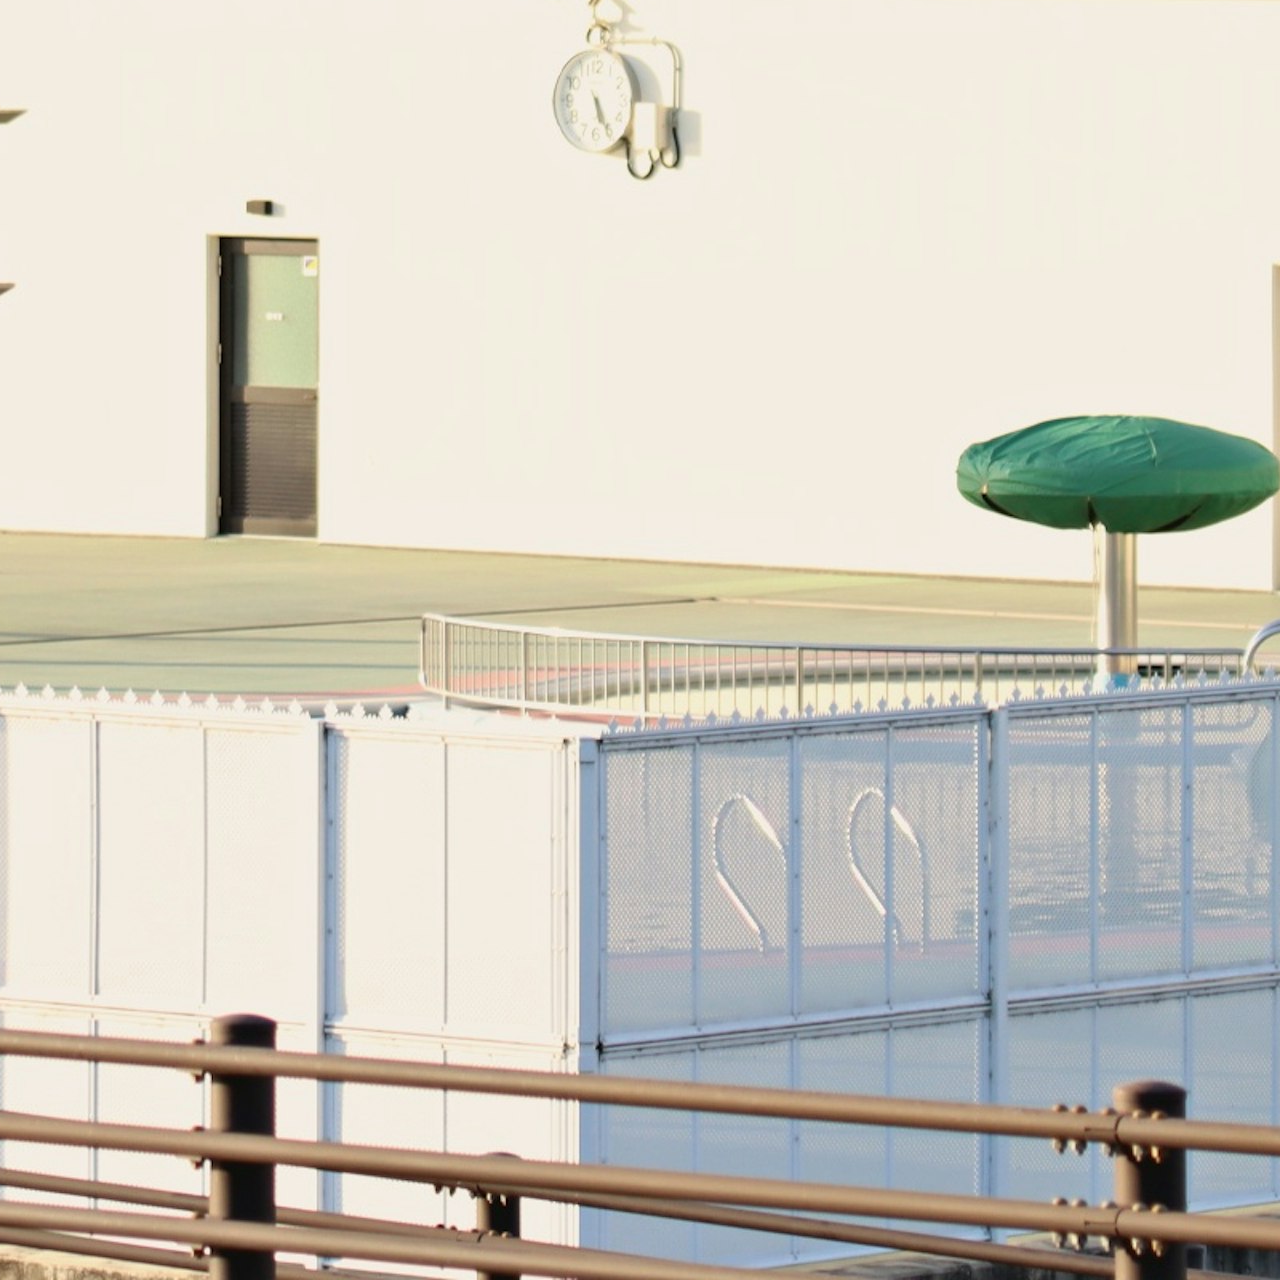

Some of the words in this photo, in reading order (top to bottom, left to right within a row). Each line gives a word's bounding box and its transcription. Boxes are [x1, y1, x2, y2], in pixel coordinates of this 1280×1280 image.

[591, 60, 604, 74] 12
[566, 76, 580, 90] 10
[616, 76, 624, 90] 2
[566, 93, 573, 108] 9
[570, 110, 578, 124] 8
[580, 123, 588, 137] 7
[591, 127, 600, 141] 6
